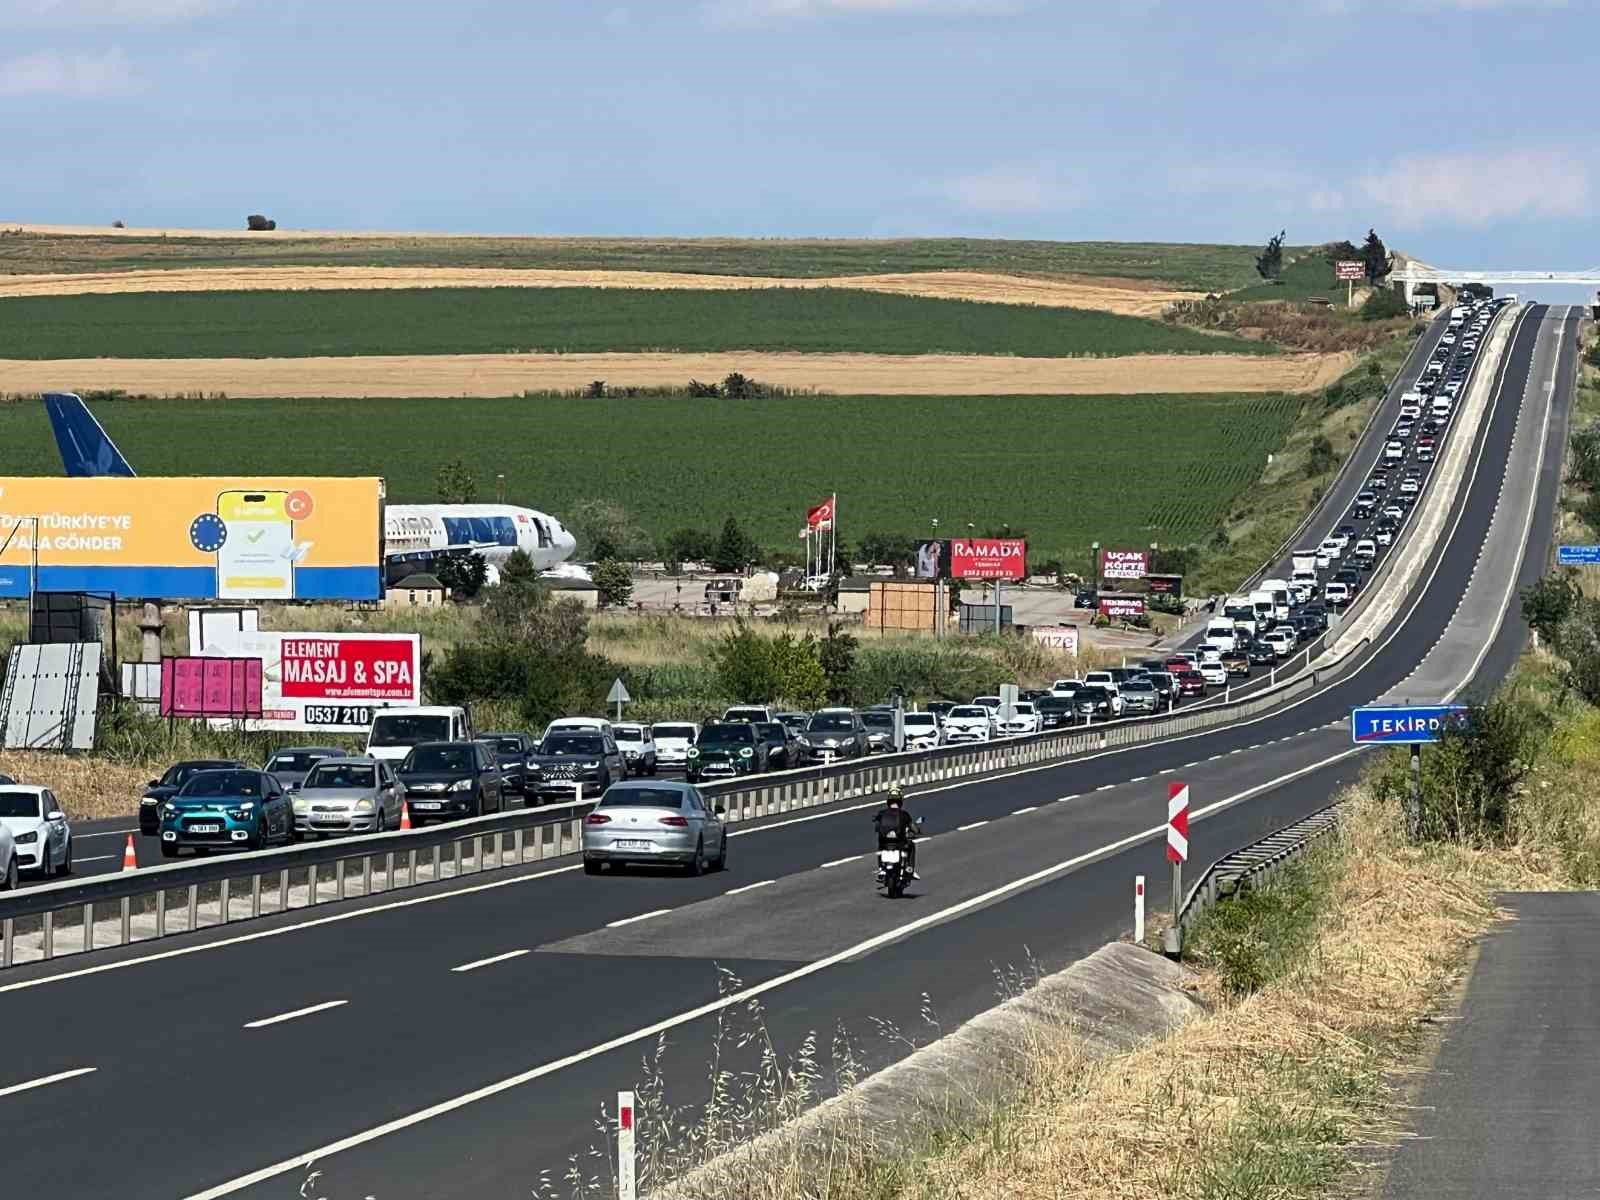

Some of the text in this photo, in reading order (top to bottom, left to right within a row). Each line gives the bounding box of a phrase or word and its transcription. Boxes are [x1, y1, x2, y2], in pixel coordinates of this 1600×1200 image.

[40, 512, 131, 530] TÜRKİYE'YE
[55, 532, 123, 550] GÖNDER
[955, 543, 1020, 557] RAMADA
[1107, 551, 1143, 561] UÇAK
[1105, 561, 1145, 570] KÖFTE
[284, 642, 339, 658] ELEMENT
[284, 660, 411, 684] MASAJ & SPA
[306, 707, 339, 723] 0537
[343, 708, 368, 724] 210
[1370, 714, 1466, 732] TEKİRD
